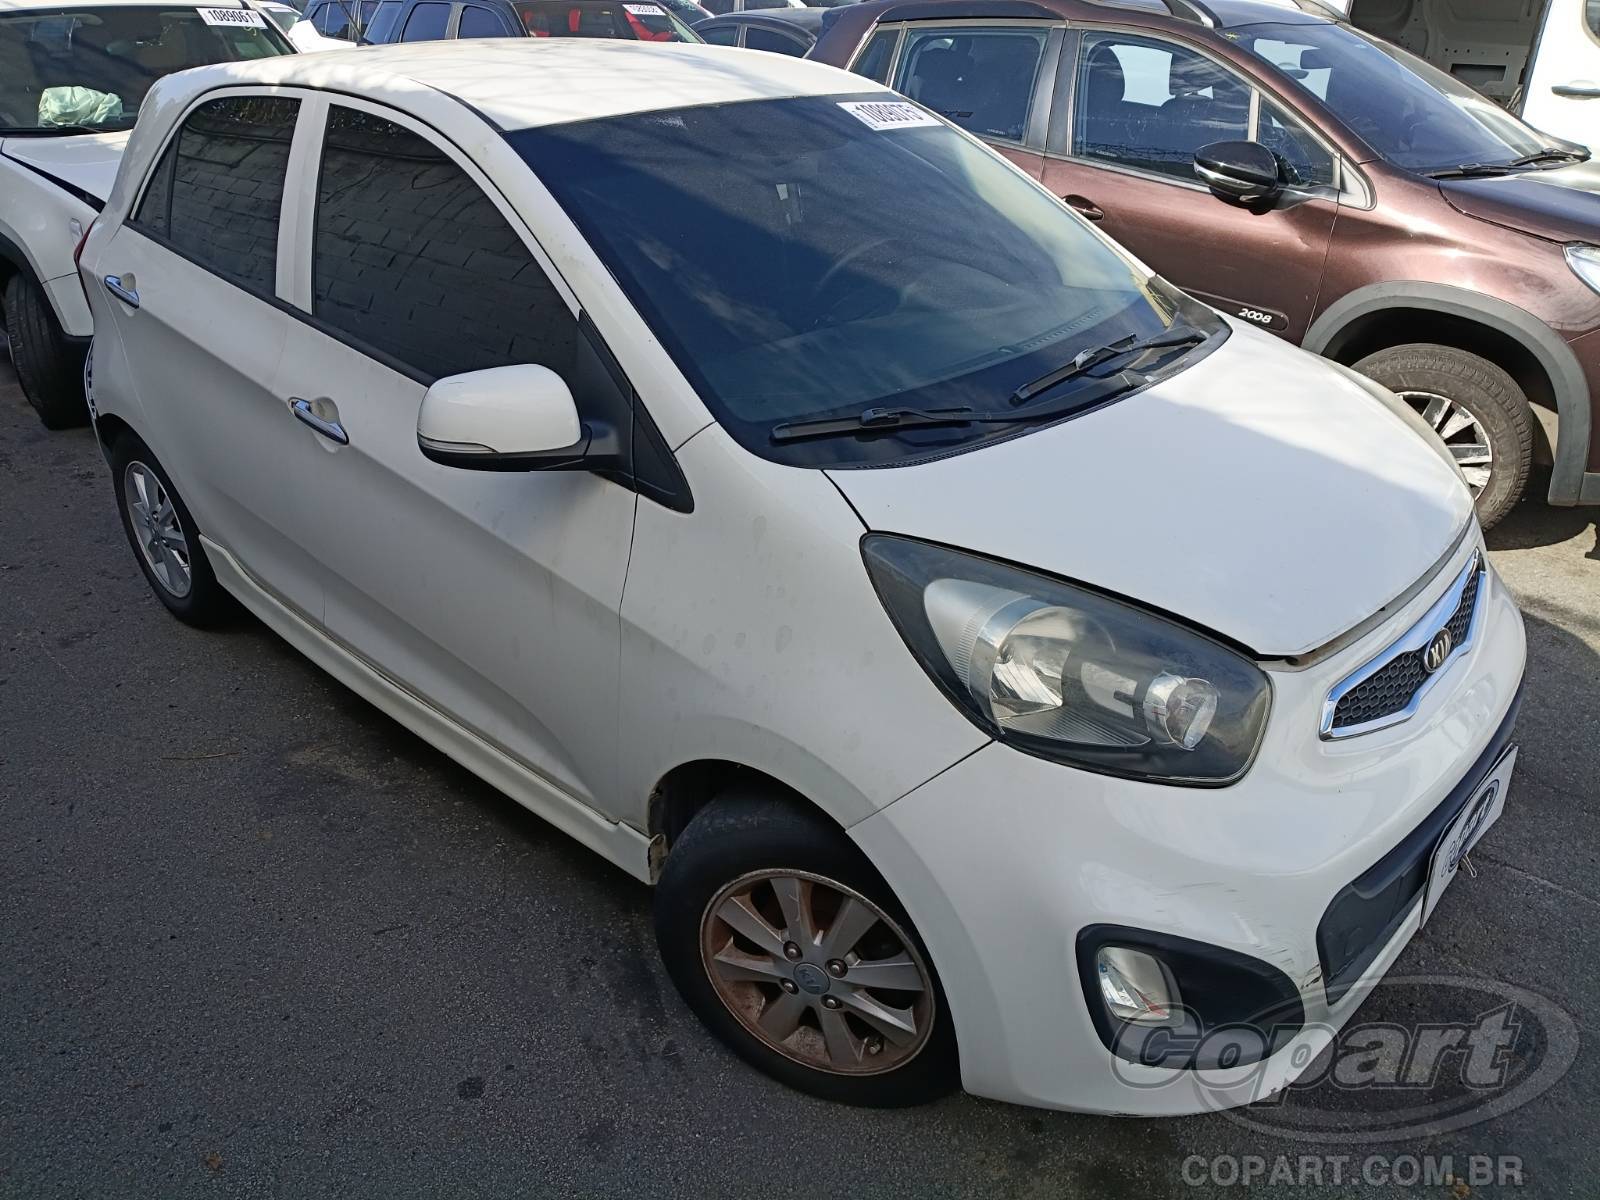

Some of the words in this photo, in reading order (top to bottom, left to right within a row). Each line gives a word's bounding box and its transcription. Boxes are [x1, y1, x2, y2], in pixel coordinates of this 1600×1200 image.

[207, 10, 255, 23] 1089061
[855, 104, 924, 122] 1089075
[1238, 308, 1273, 323] 2008
[1430, 633, 1450, 668] KIA
